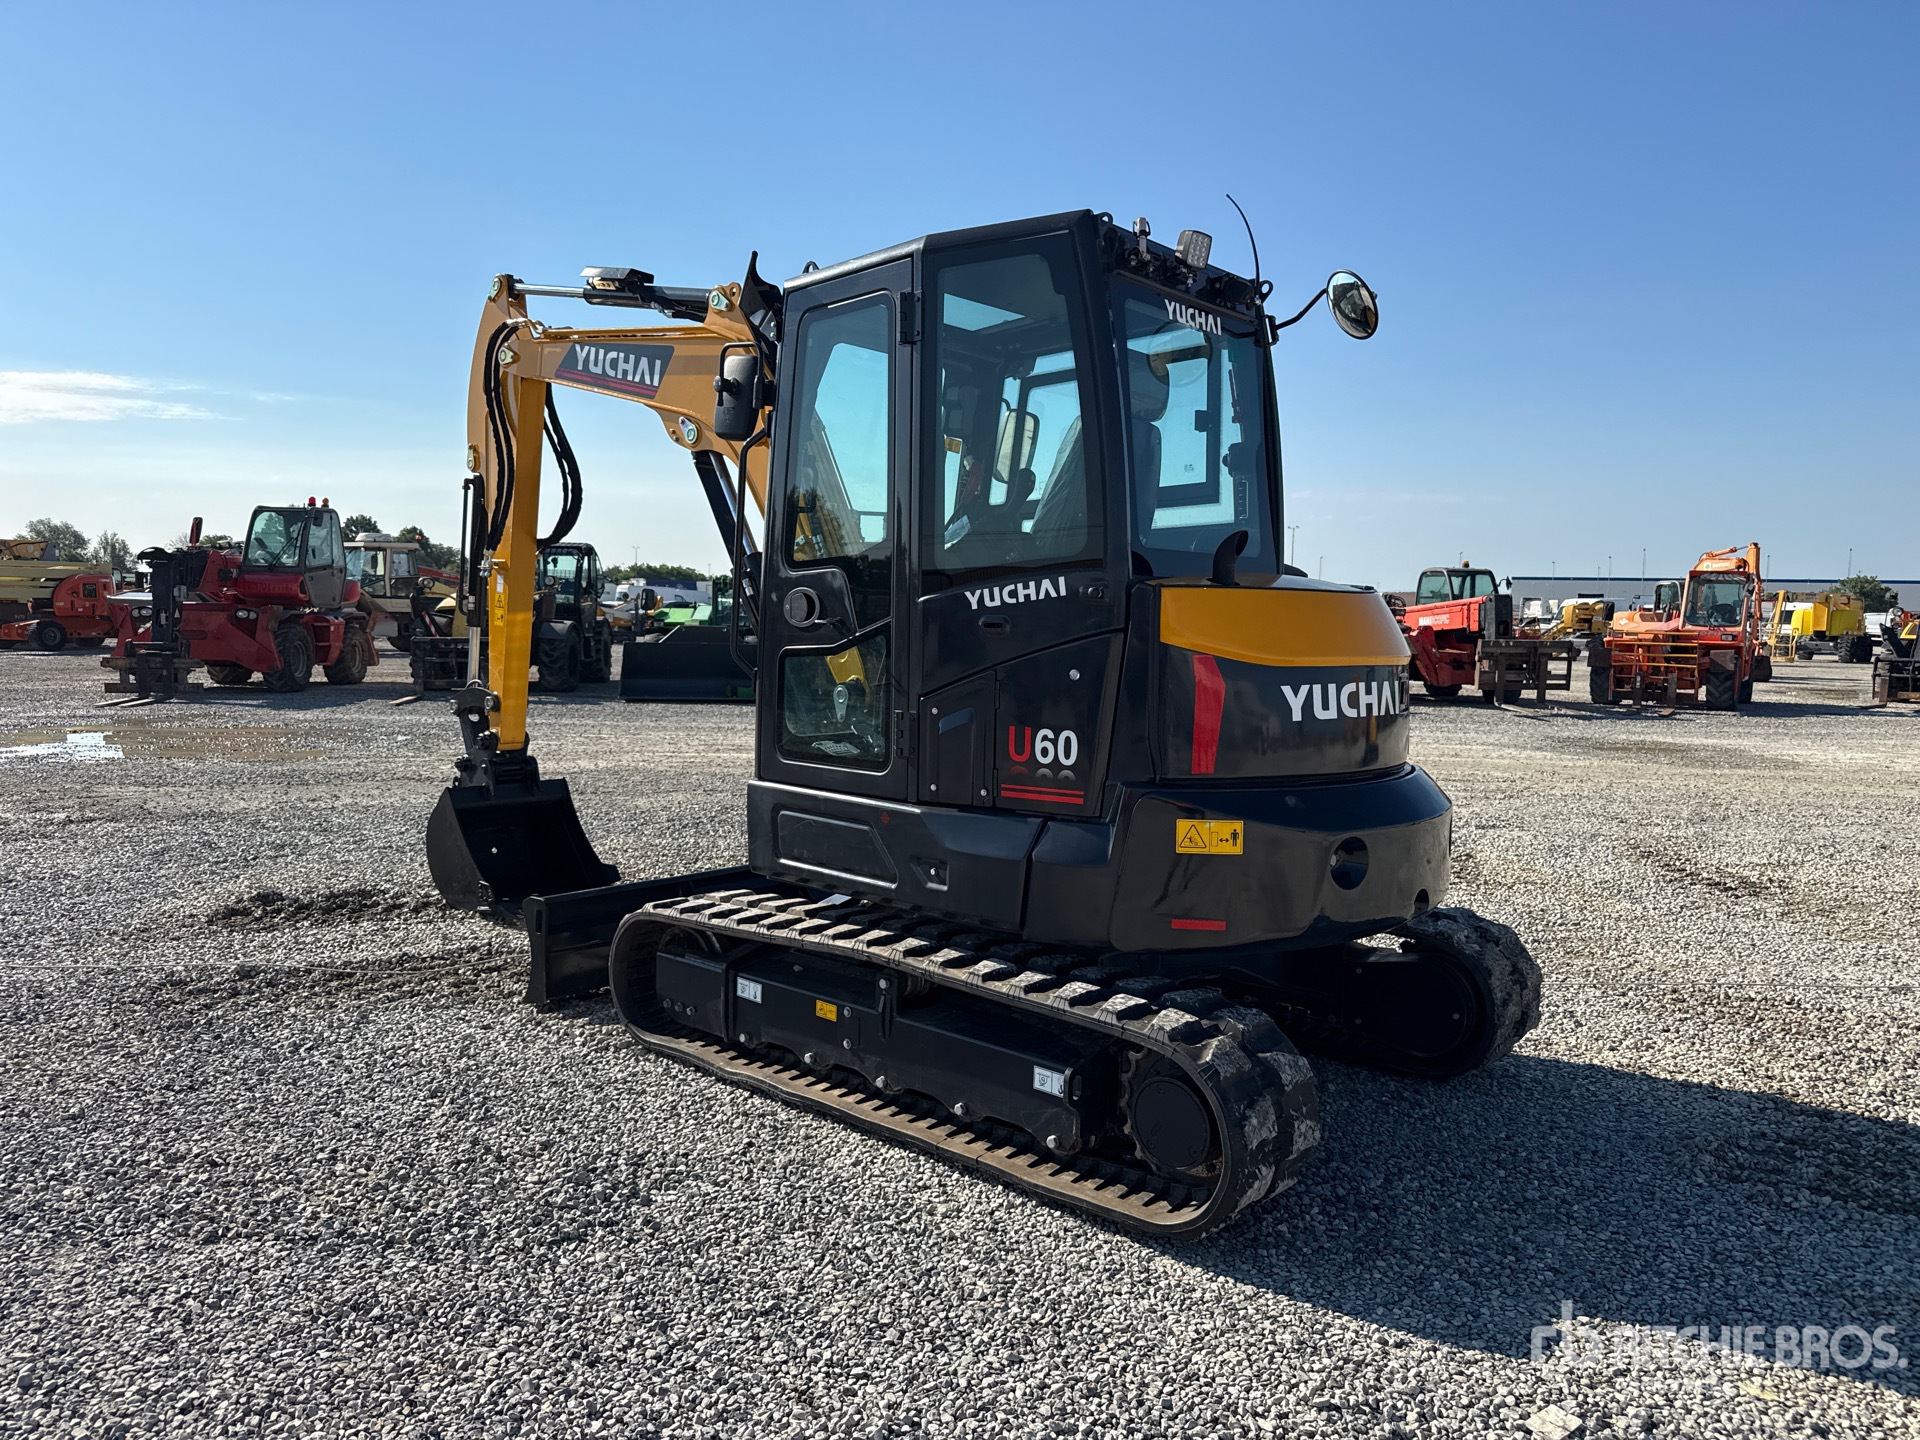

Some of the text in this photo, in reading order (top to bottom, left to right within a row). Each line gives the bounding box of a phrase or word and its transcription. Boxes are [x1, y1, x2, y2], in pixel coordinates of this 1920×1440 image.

[1164, 299, 1222, 336] YUCHAI
[574, 343, 662, 387] YUCHAI
[964, 576, 1067, 610] YUCHAI
[1280, 680, 1400, 722] YUCHAI
[1008, 725, 1079, 766] U60
